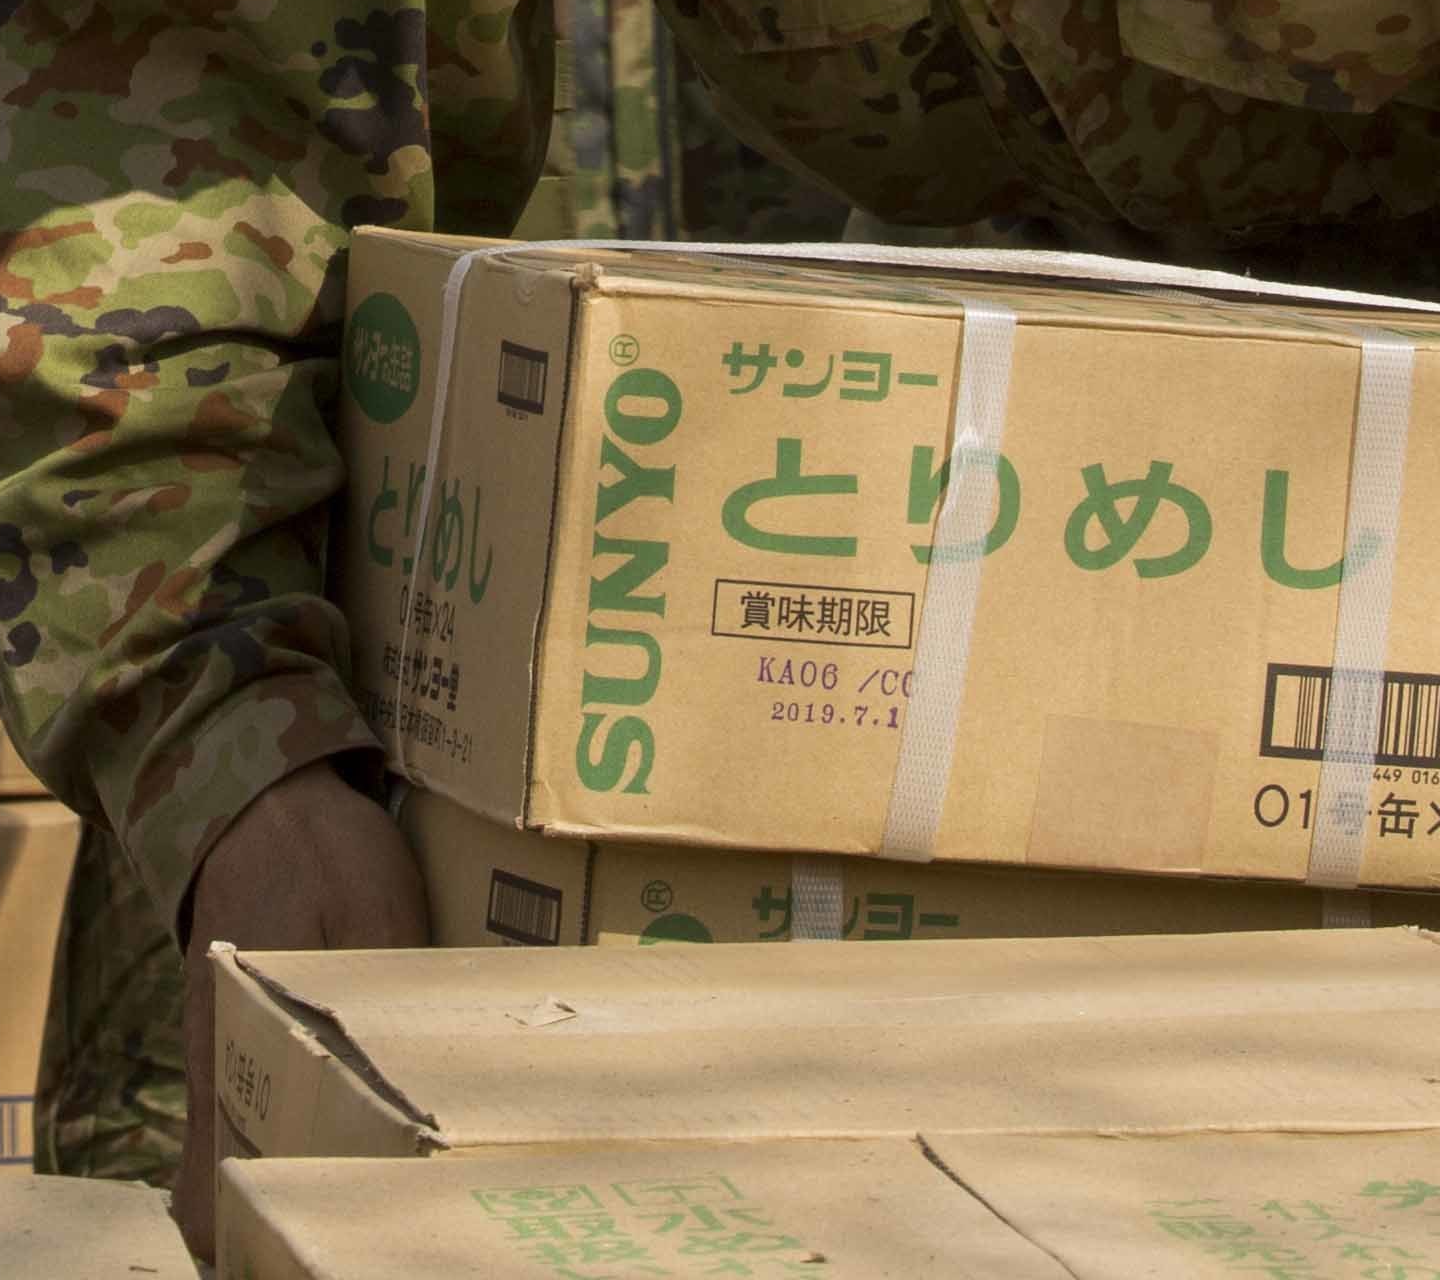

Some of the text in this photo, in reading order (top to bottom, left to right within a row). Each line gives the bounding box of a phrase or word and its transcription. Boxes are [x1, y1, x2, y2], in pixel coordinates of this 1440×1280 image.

[723, 341, 939, 404] サンヨー
[367, 455, 495, 605] とりめし
[721, 438, 1383, 590] とりめし
[575, 366, 683, 797] SUNYO
[740, 590, 891, 638] 賞味期限
[771, 701, 899, 729] 2019.7.1
[1372, 768, 1402, 783] 449
[753, 883, 960, 939] サヨー
